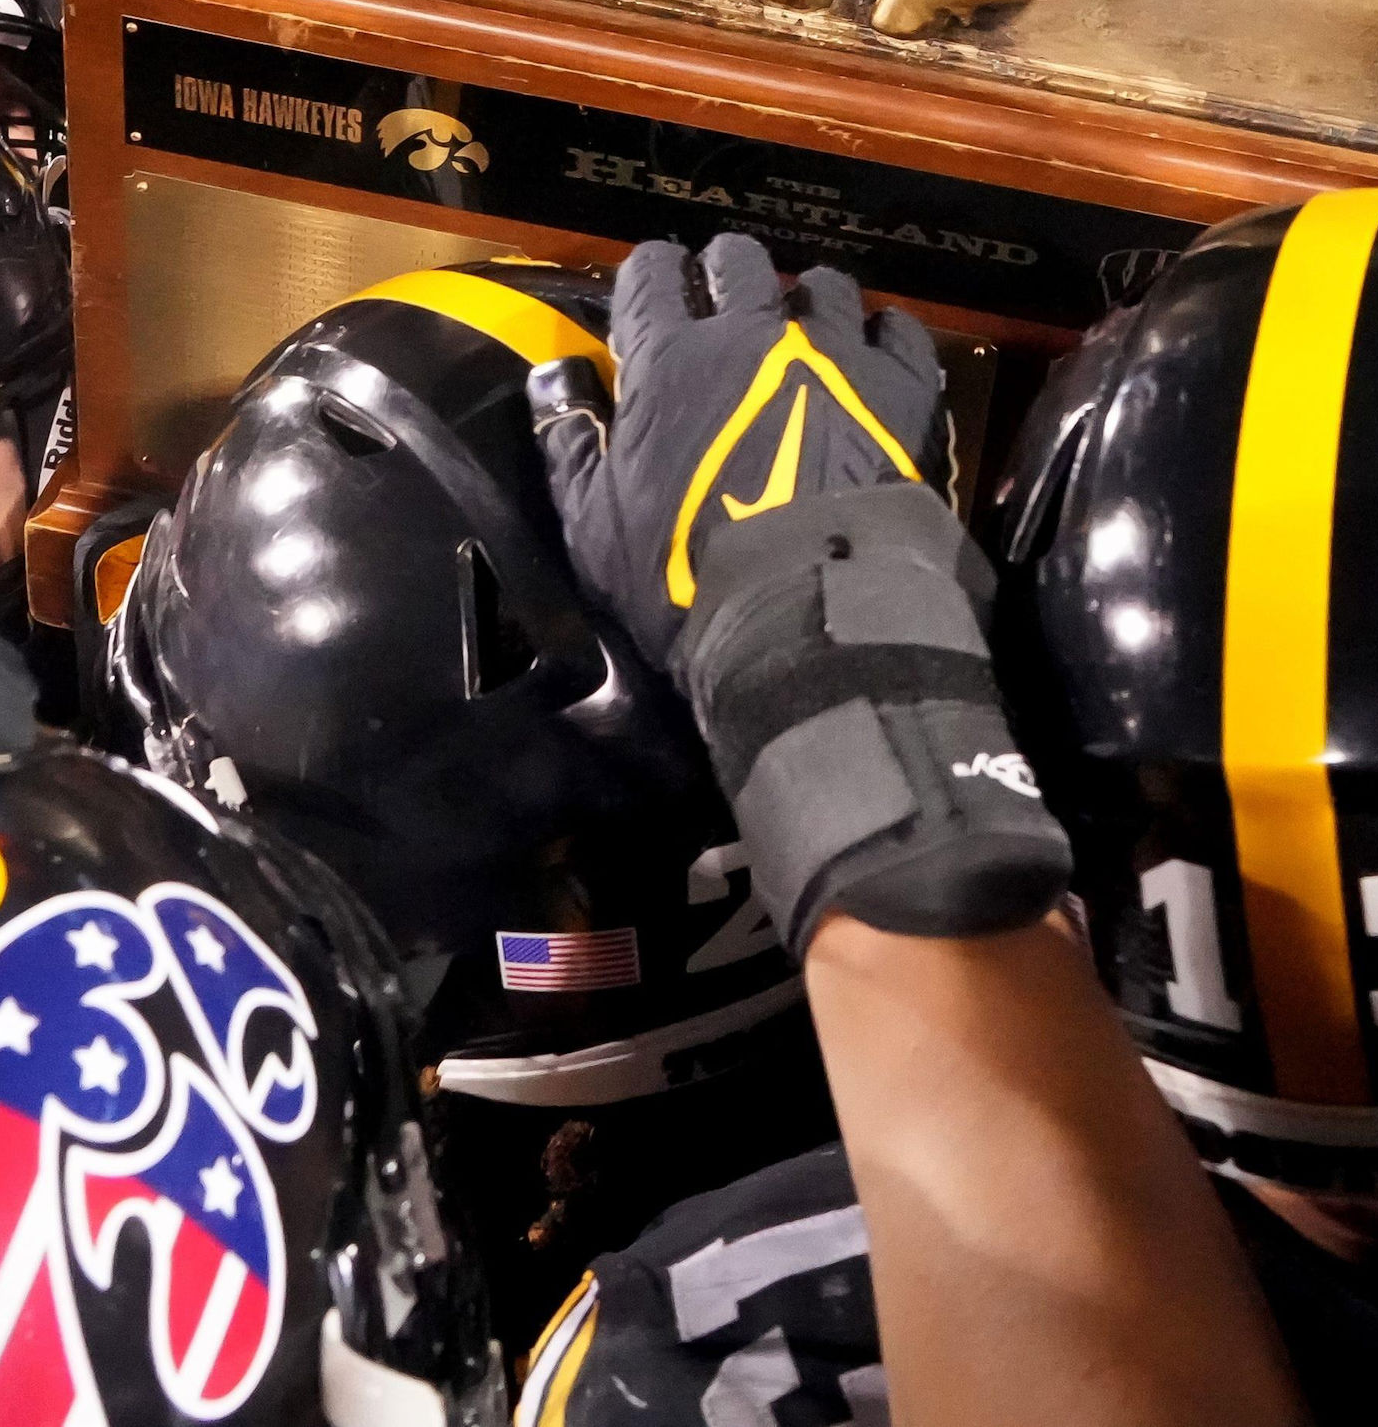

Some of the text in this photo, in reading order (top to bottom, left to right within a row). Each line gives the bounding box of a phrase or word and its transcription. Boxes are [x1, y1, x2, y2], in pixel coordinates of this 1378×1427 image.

[174, 74, 363, 144] IOWA HAWKEYES
[564, 146, 1040, 266] HEARTLAND
